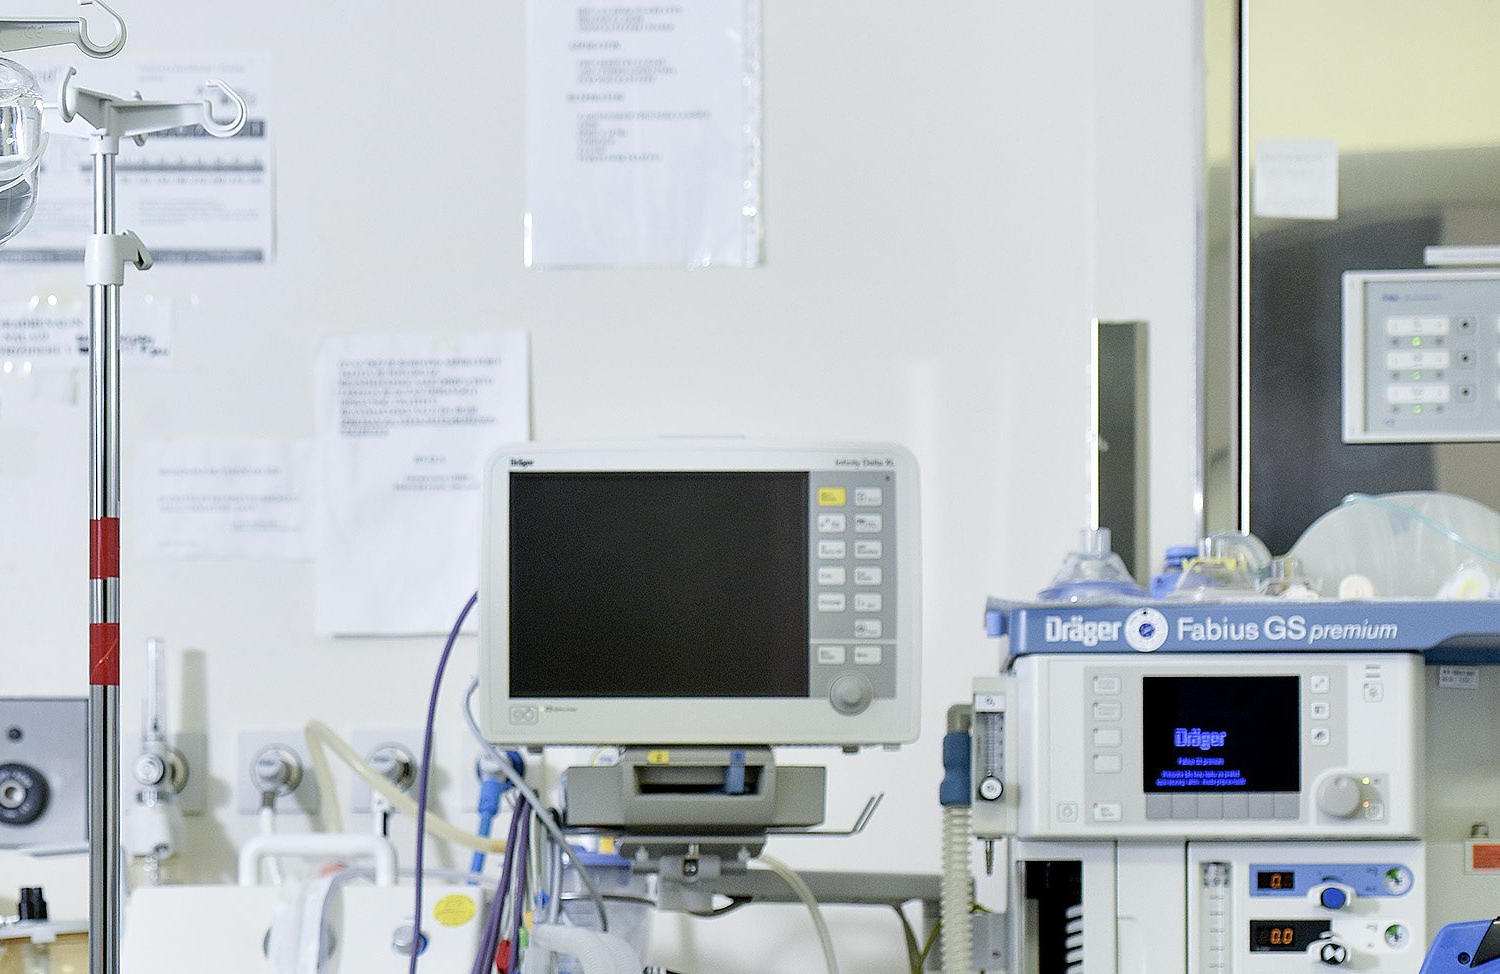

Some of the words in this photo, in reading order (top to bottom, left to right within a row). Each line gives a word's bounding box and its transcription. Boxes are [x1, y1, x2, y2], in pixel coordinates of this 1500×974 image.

[1045, 615, 1122, 647] Dräger
[1177, 617, 1260, 642] Fabius
[1263, 614, 1307, 642] GS
[1308, 618, 1399, 645] premium
[1174, 728, 1227, 750] Dräger
